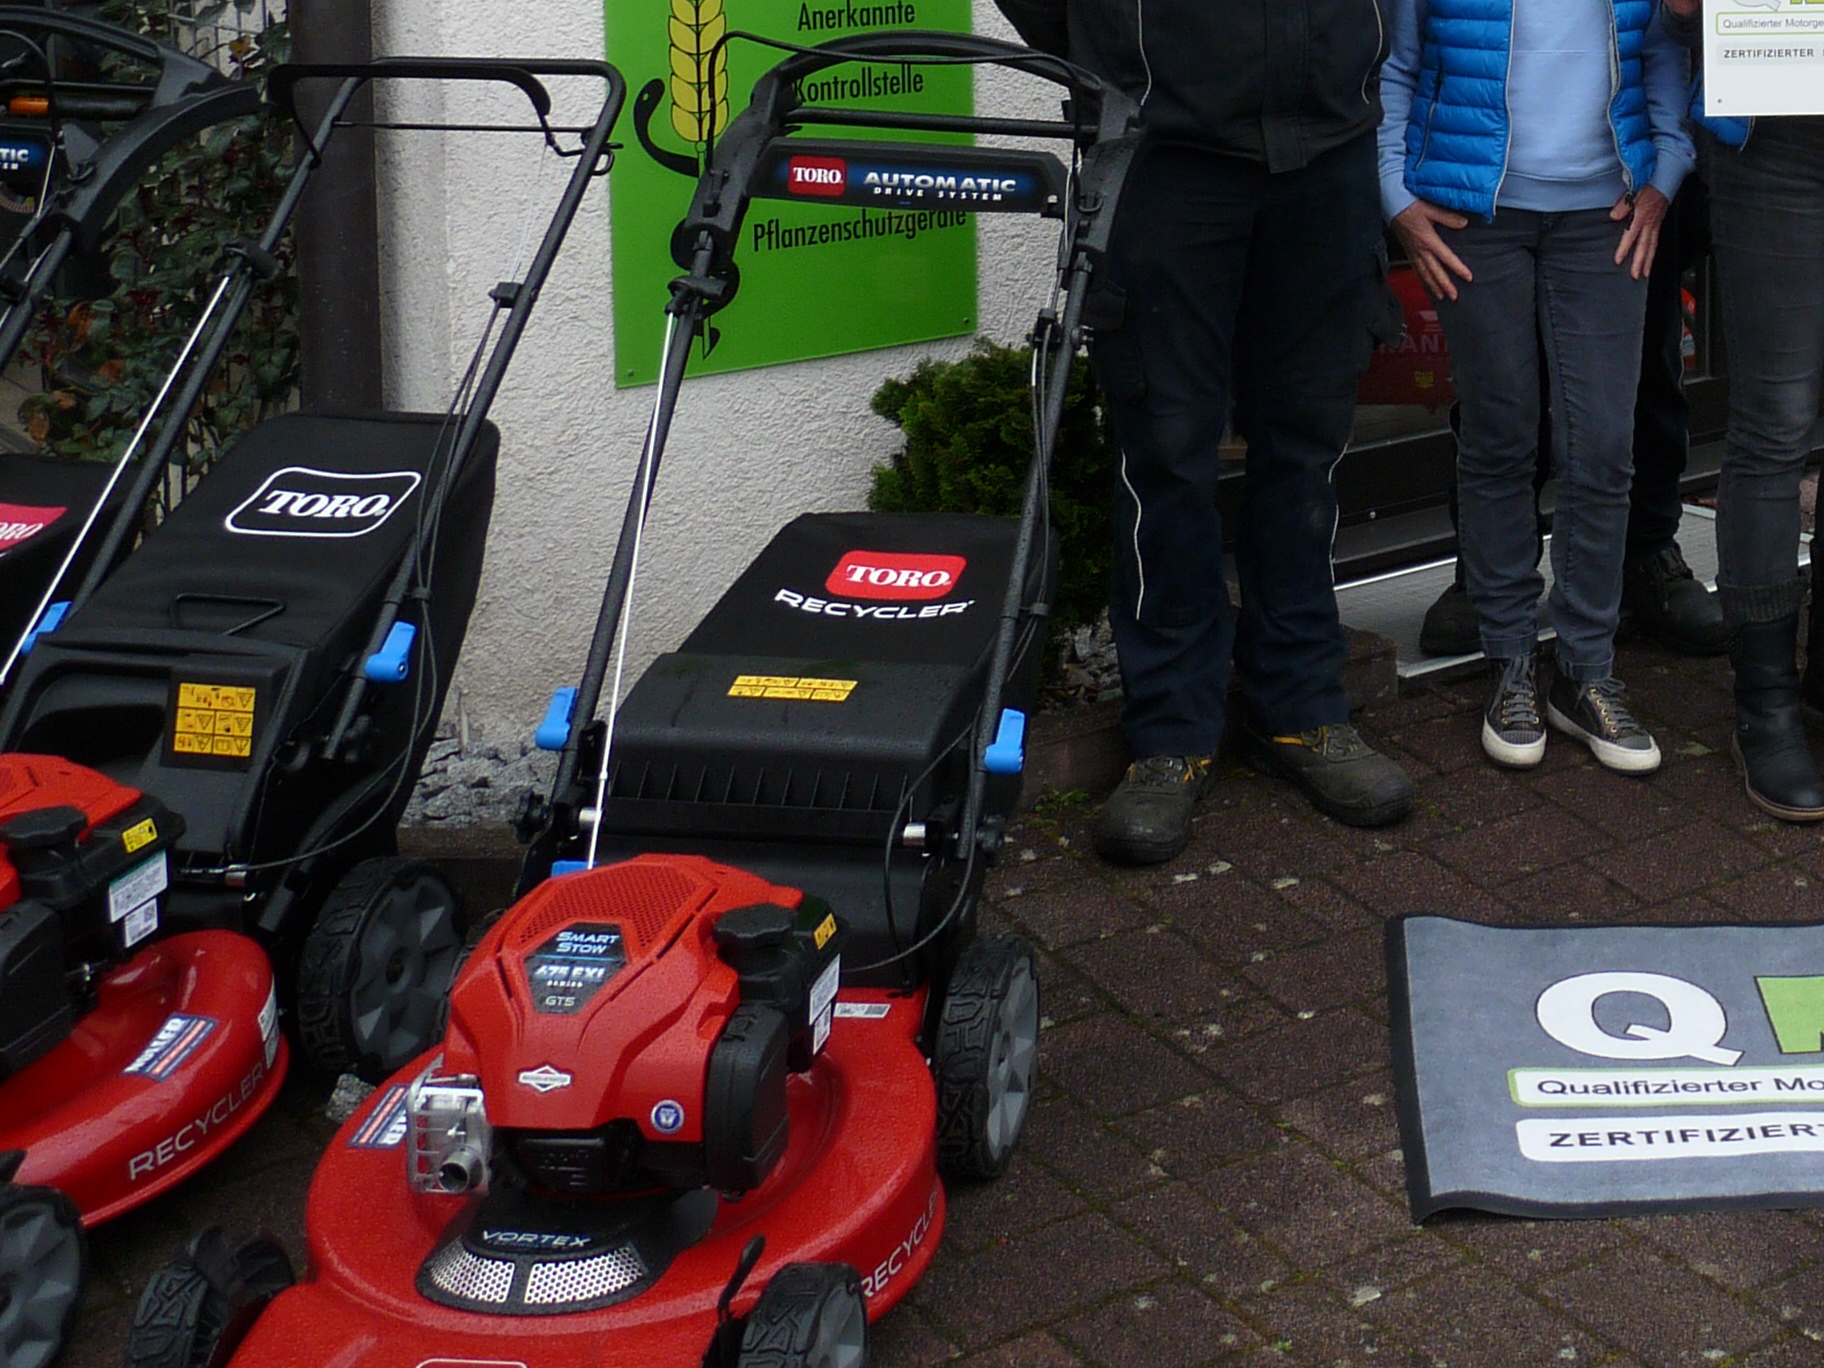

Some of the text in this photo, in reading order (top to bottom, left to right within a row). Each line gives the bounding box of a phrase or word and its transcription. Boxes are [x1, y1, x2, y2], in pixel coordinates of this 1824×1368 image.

[1723, 18, 1782, 29] Qualifizierter
[1724, 49, 1815, 59] ZERTIFIZIERTER
[793, 167, 1017, 193] TORO AUTOMATIC
[873, 187, 1003, 201] DRIVE SYSTEM
[259, 489, 386, 519] TORO
[846, 564, 951, 588] TORO
[774, 588, 976, 619] RECYCLER
[556, 931, 619, 943] SMART
[556, 942, 608, 954] STOW
[545, 996, 576, 1006] GTS
[1537, 1074, 1765, 1099] Qualifizierter
[129, 1062, 264, 1180] RECYCLER
[483, 1230, 591, 1248] VORTEX
